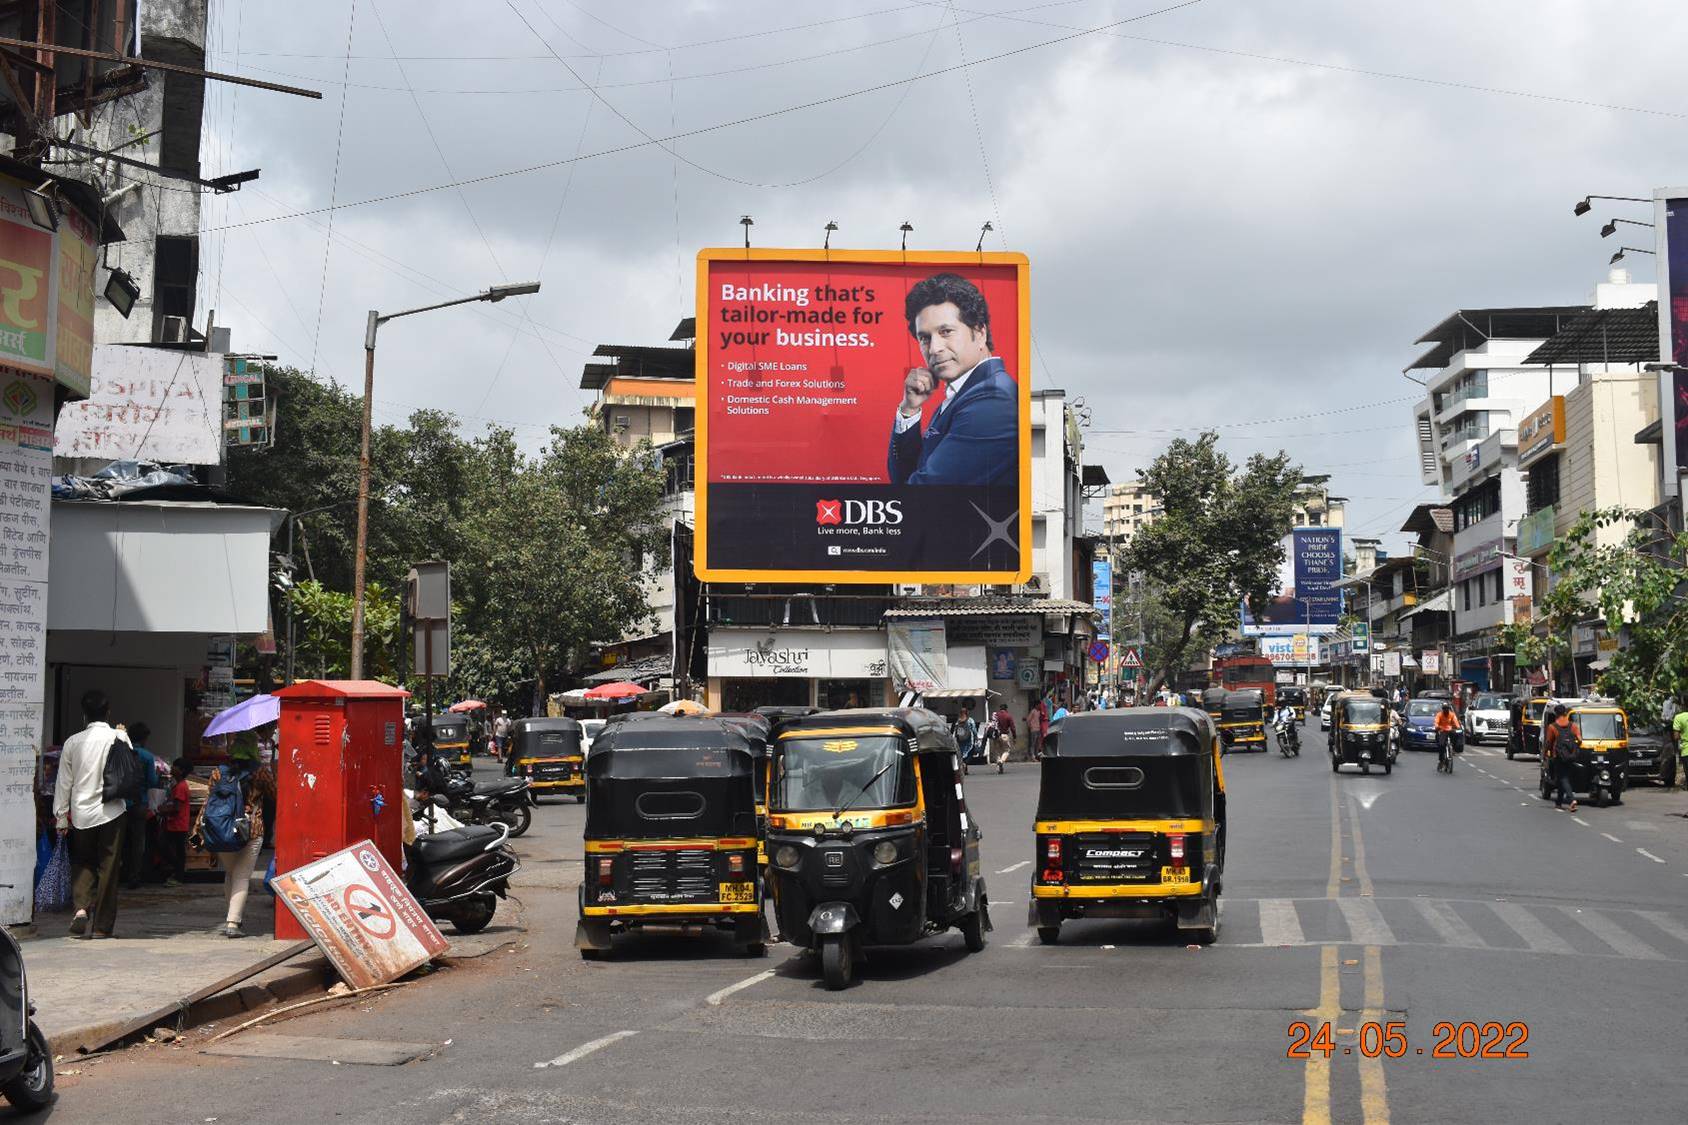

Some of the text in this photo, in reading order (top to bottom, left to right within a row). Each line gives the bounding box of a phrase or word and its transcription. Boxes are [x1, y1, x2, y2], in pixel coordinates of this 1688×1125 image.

[721, 283, 875, 307] Banking that's
[720, 306, 884, 324] tailor-made for
[720, 328, 875, 349] your business.
[727, 361, 808, 372] Digital SME Loans
[727, 378, 845, 389] Trade and Forex Solutions
[727, 395, 857, 406] Domestic Cash Management
[727, 406, 769, 415] Solutions
[844, 499, 904, 525] DBS
[817, 526, 902, 536] Live more, Bank less
[744, 648, 808, 667] Jayashri
[769, 664, 808, 675] Collection
[322, 892, 373, 952] NO ENTRY
